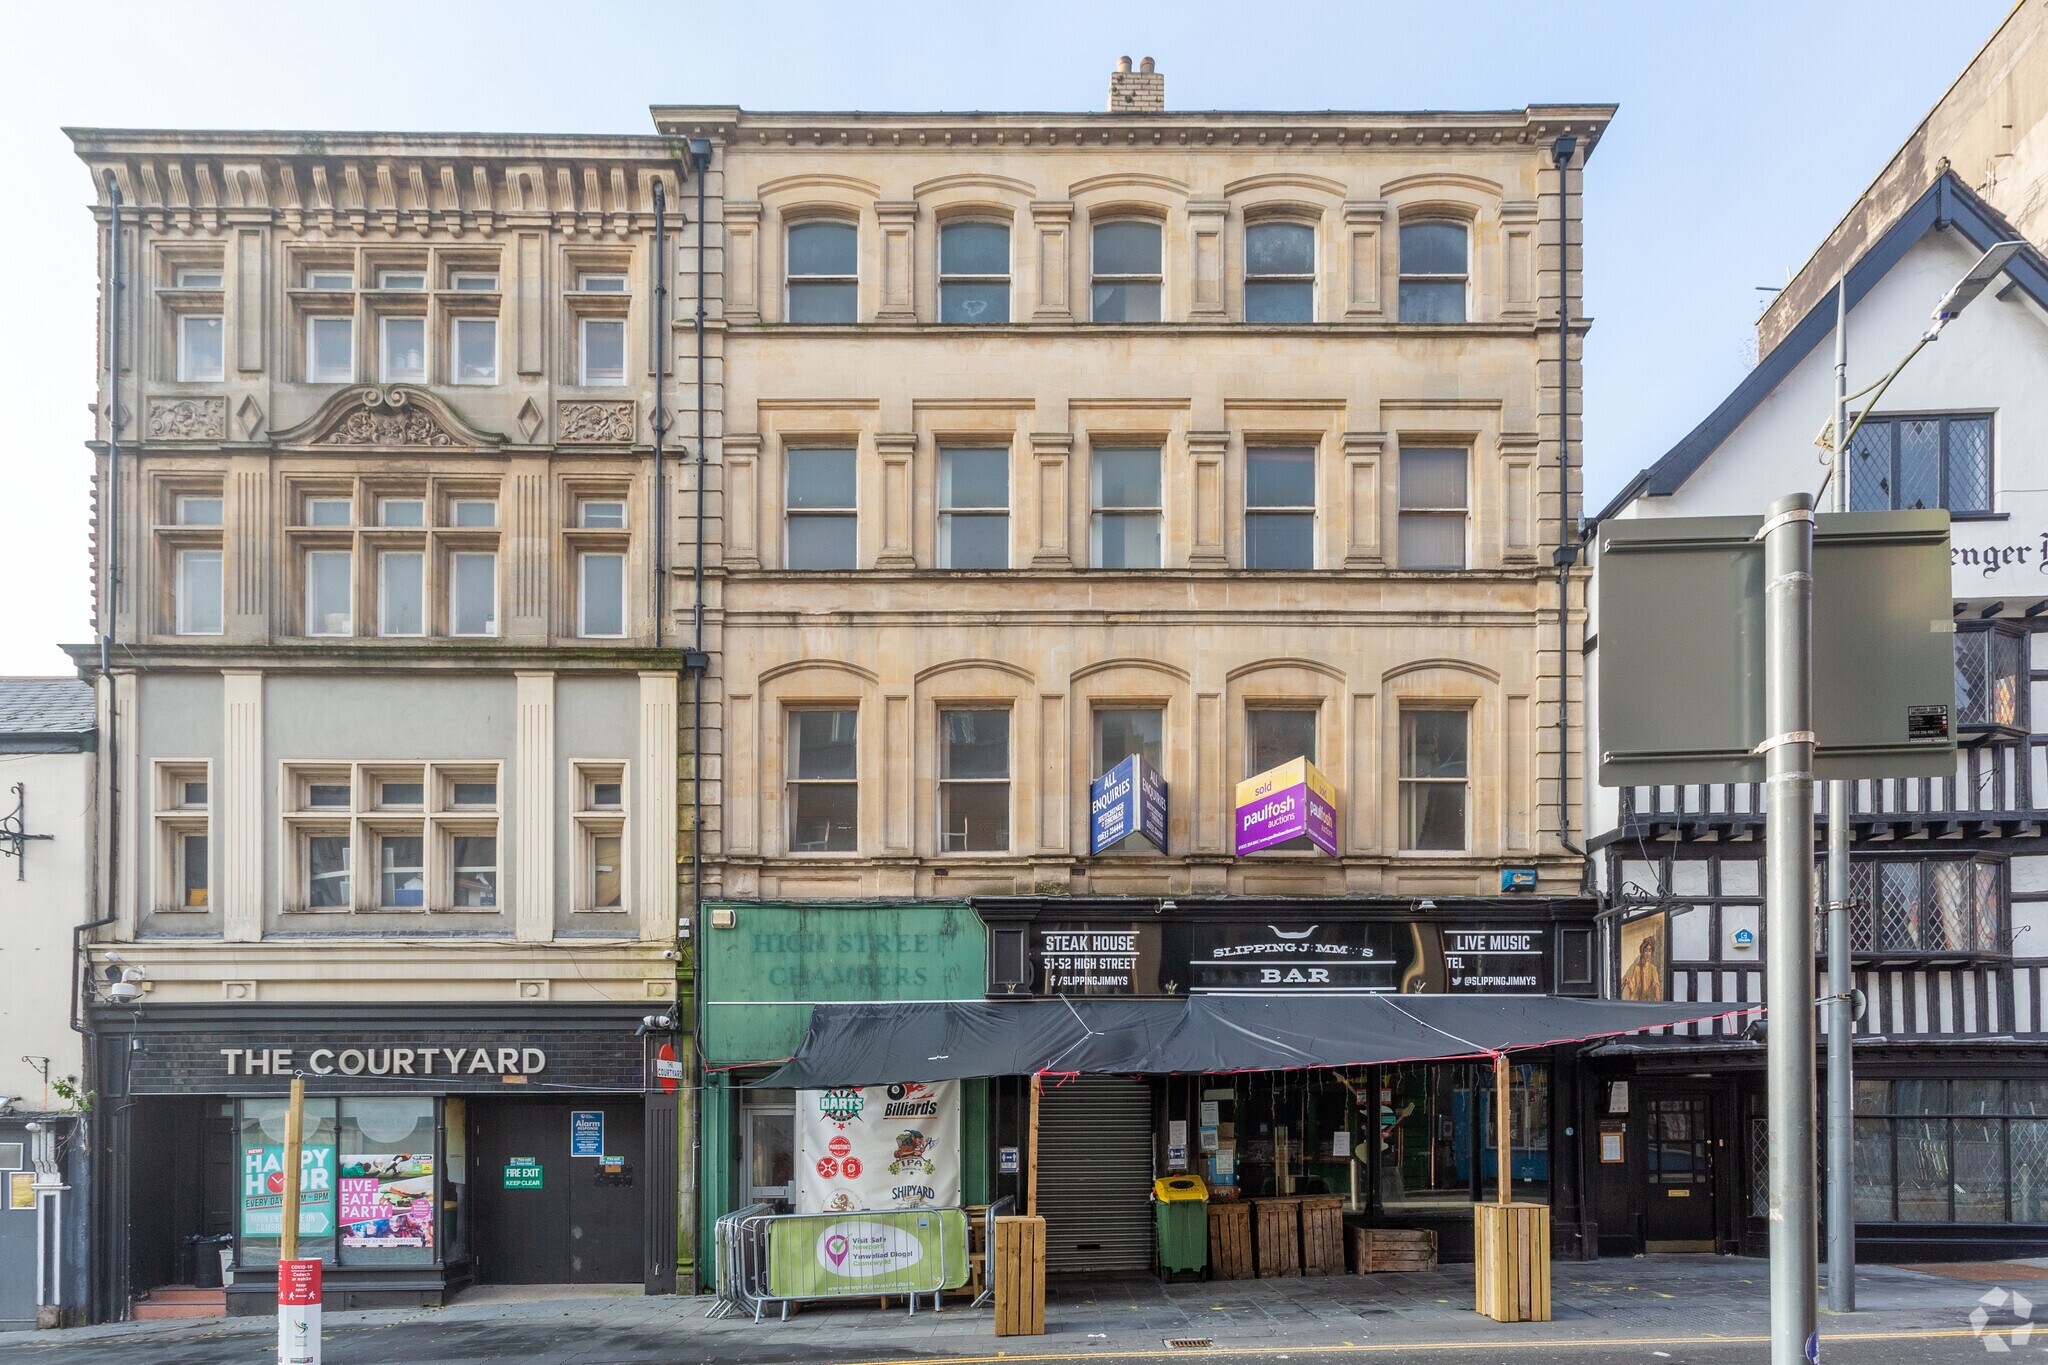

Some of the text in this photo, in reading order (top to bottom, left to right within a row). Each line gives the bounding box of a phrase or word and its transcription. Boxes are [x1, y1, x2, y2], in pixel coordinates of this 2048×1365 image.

[1104, 771, 1118, 791] ALL
[1149, 770, 1159, 788] ALL
[1142, 777, 1167, 812] ENQUIRIES
[1254, 780, 1272, 796] sold
[1092, 778, 1131, 815] ENQUIRIES
[1243, 795, 1295, 831] paulfosh
[1267, 812, 1296, 829] auctions
[752, 933, 944, 953] HIGH STREET
[1046, 935, 1135, 951] STEAK HOUSE
[1457, 935, 1530, 950] LIVE MUSIC
[1213, 943, 1297, 958] SLIPPING
[1044, 957, 1137, 970] 51-52 HIGH STREET
[1446, 957, 1465, 969] TEL
[768, 966, 928, 986] CHAMBERS
[1058, 976, 1128, 986] /SLIPPINGJIMMYS
[1260, 968, 1330, 983] BAR
[1464, 976, 1537, 986] @SLIPPINGJIMMYS
[220, 1048, 547, 1075] THE COURTYARD
[658, 1068, 682, 1078] COURTYARD
[820, 1097, 863, 1110] DARTS
[884, 1100, 938, 1117] Billiards
[246, 1148, 330, 1173] HAPY
[506, 1168, 540, 1177] FIRE EXIT
[341, 1180, 377, 1192] LIVE.
[892, 1185, 935, 1200] SHIPYARD
[246, 1197, 268, 1208] EVERY
[270, 1196, 284, 1206] DAY
[314, 1192, 329, 1201] 9PM
[341, 1193, 371, 1205] EAT.
[341, 1205, 393, 1218] PARTY.
[852, 1243, 884, 1252] Newport
